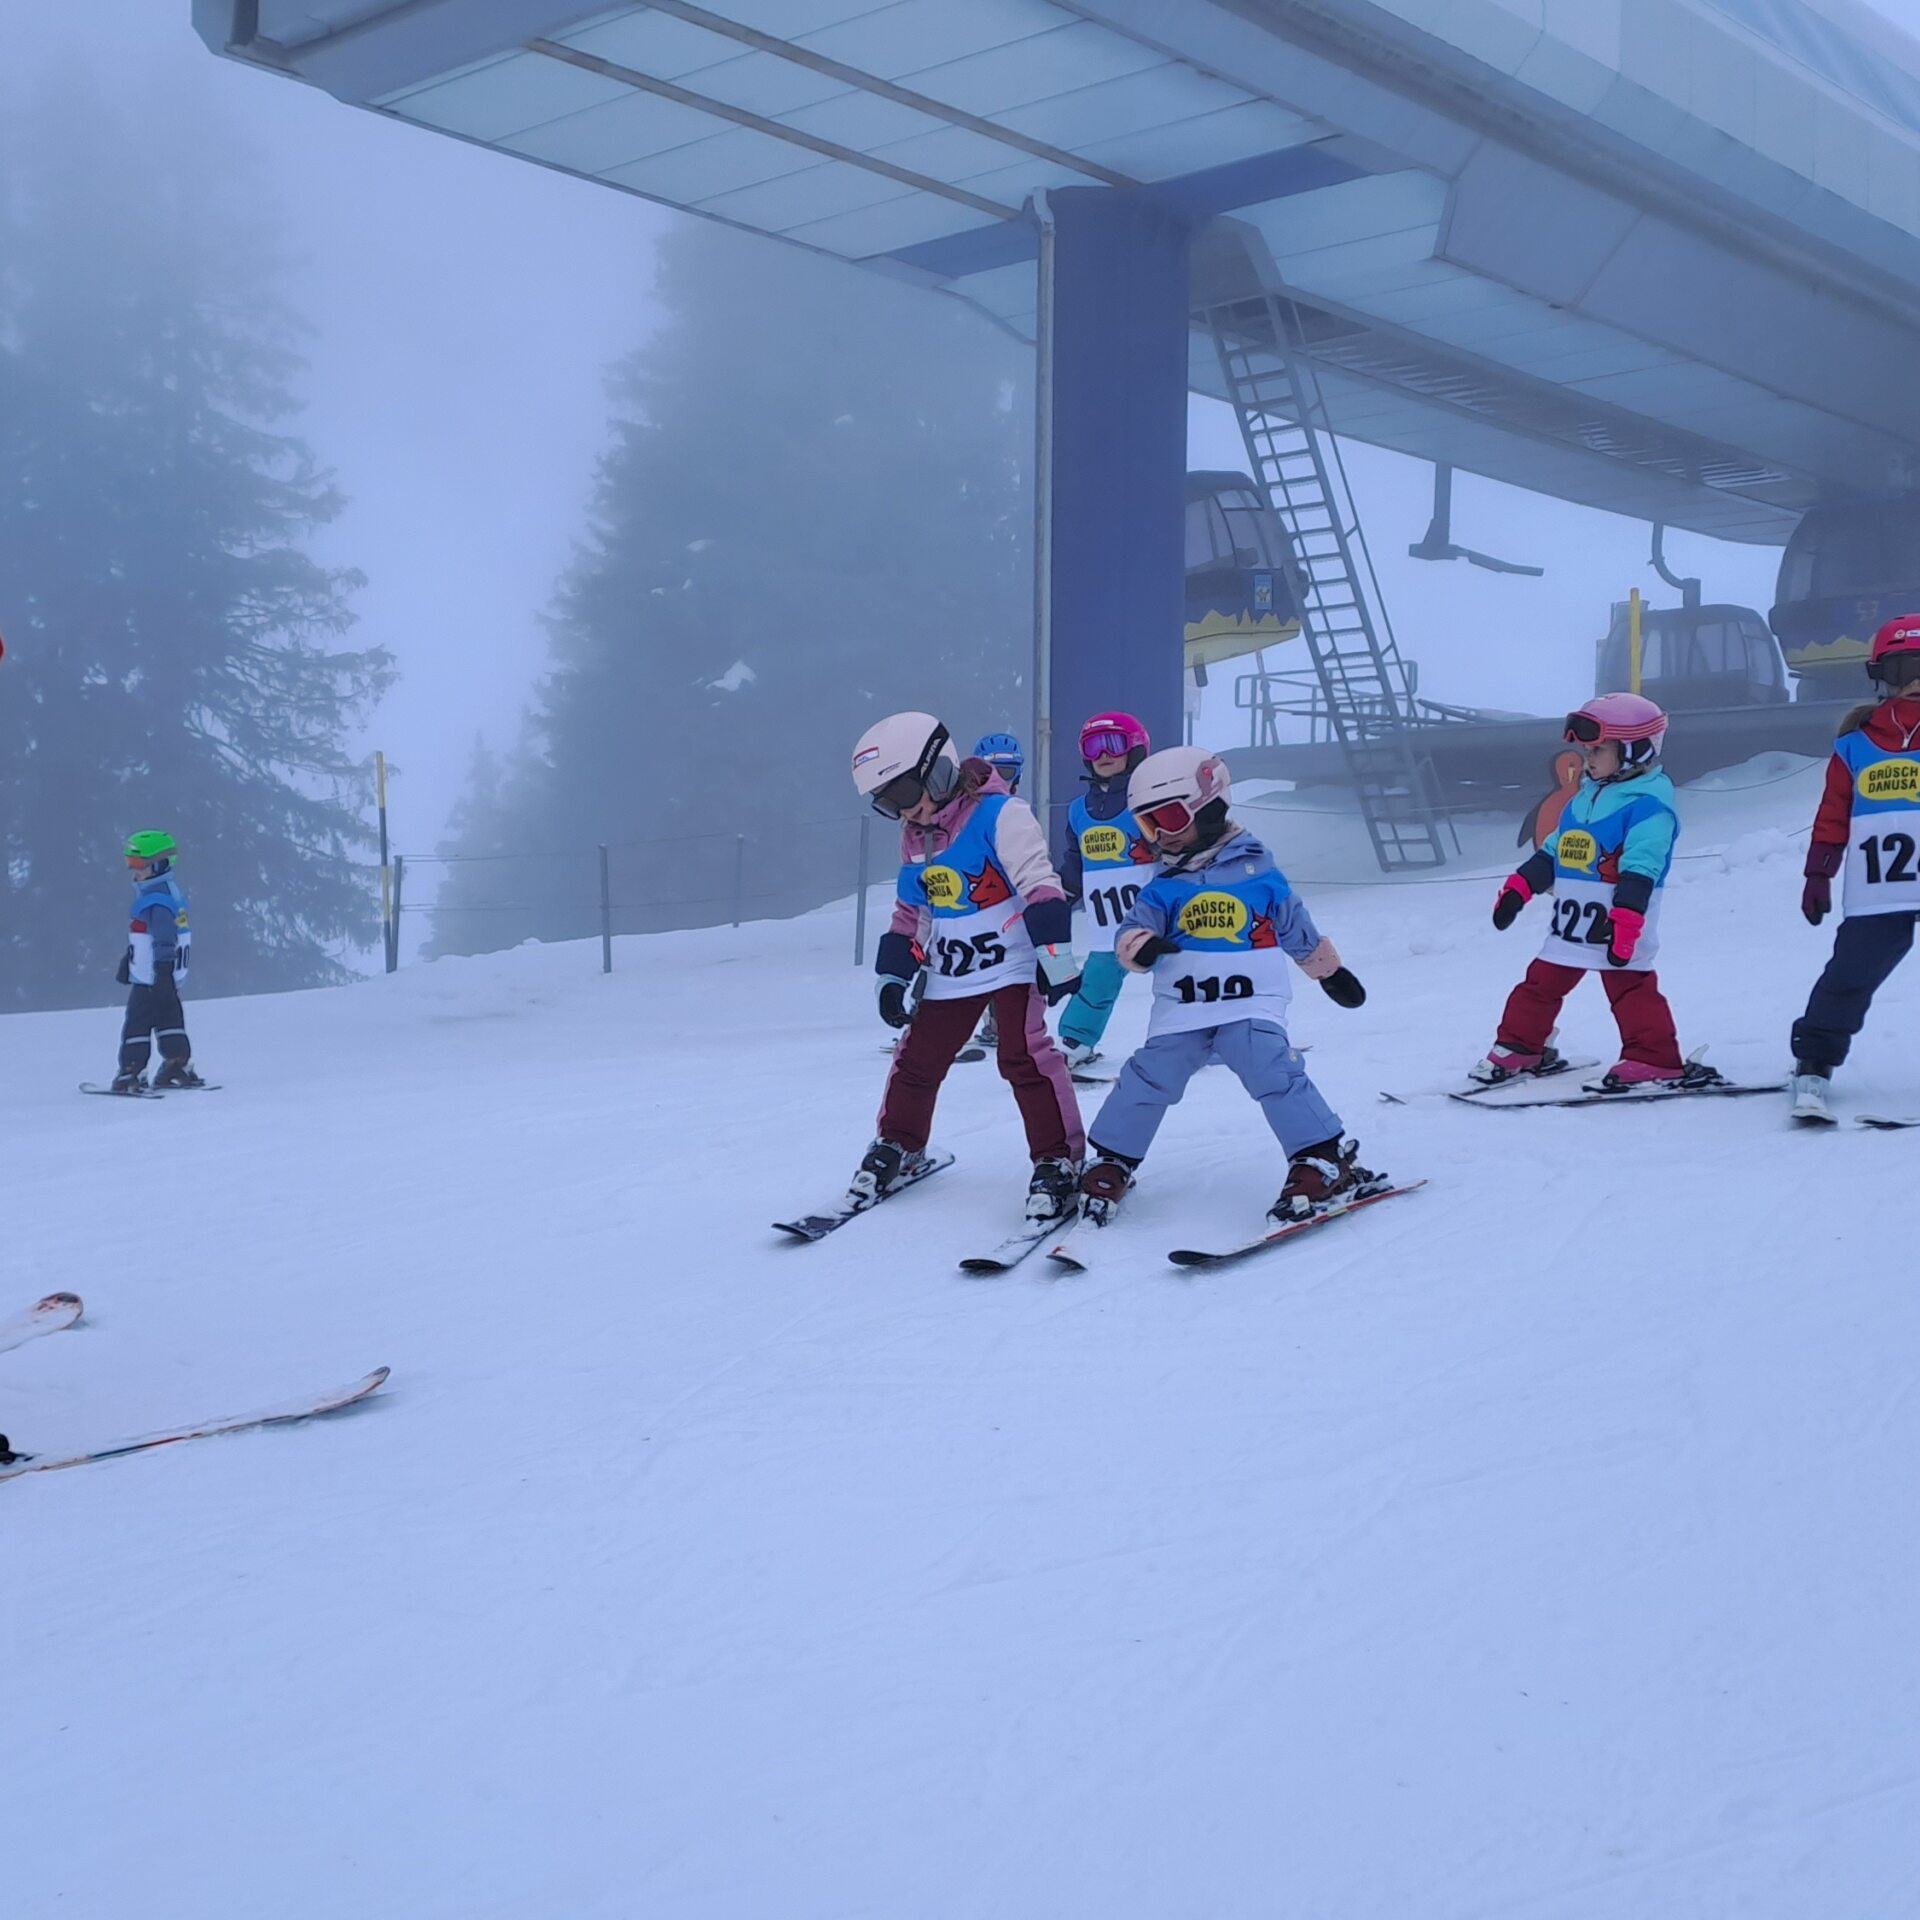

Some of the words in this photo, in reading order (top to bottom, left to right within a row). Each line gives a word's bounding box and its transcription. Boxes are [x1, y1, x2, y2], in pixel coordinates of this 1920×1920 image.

[1868, 766, 1918, 782] GRÜSCH
[1868, 779, 1917, 793] DANUSA
[1084, 831, 1117, 845] GRÜSCH
[1086, 843, 1117, 855] DANUSA
[1859, 833, 1920, 884] 12
[936, 931, 1007, 978] 125
